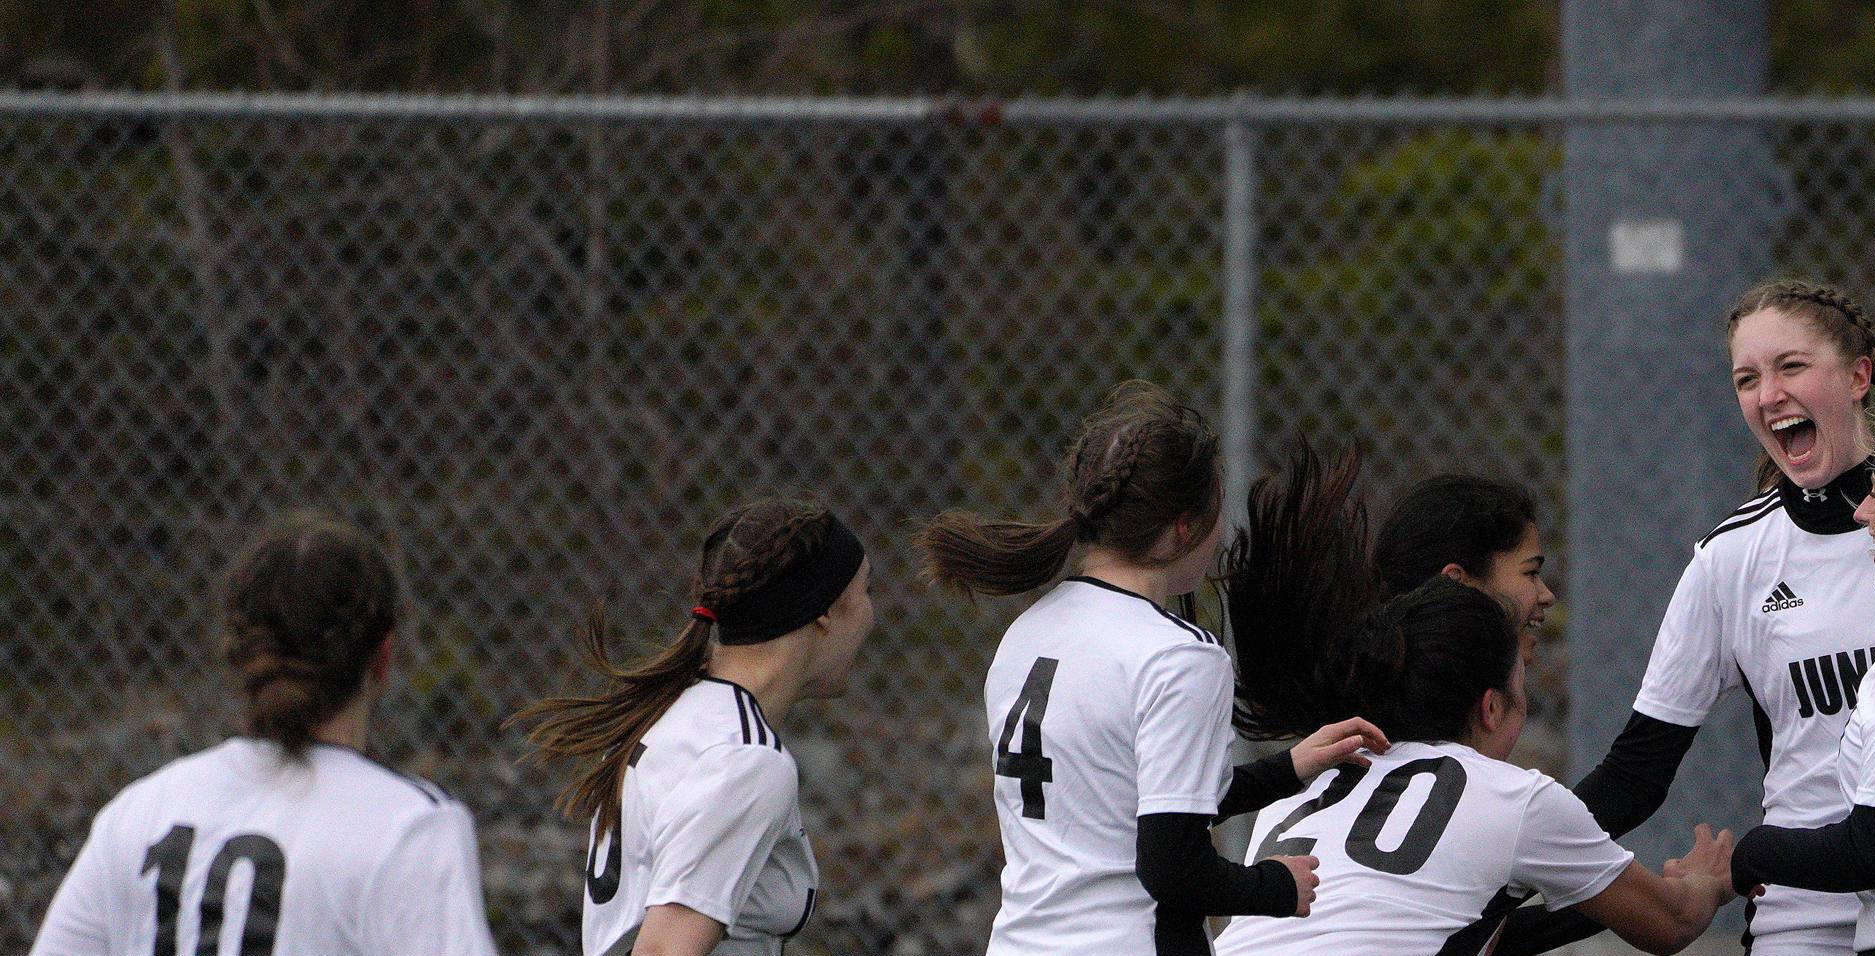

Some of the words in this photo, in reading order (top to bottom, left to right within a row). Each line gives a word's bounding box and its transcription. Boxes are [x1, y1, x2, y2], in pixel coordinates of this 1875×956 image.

[1762, 598, 1804, 613] adidas
[996, 657, 1054, 820] 4
[1253, 755, 1468, 876] 20
